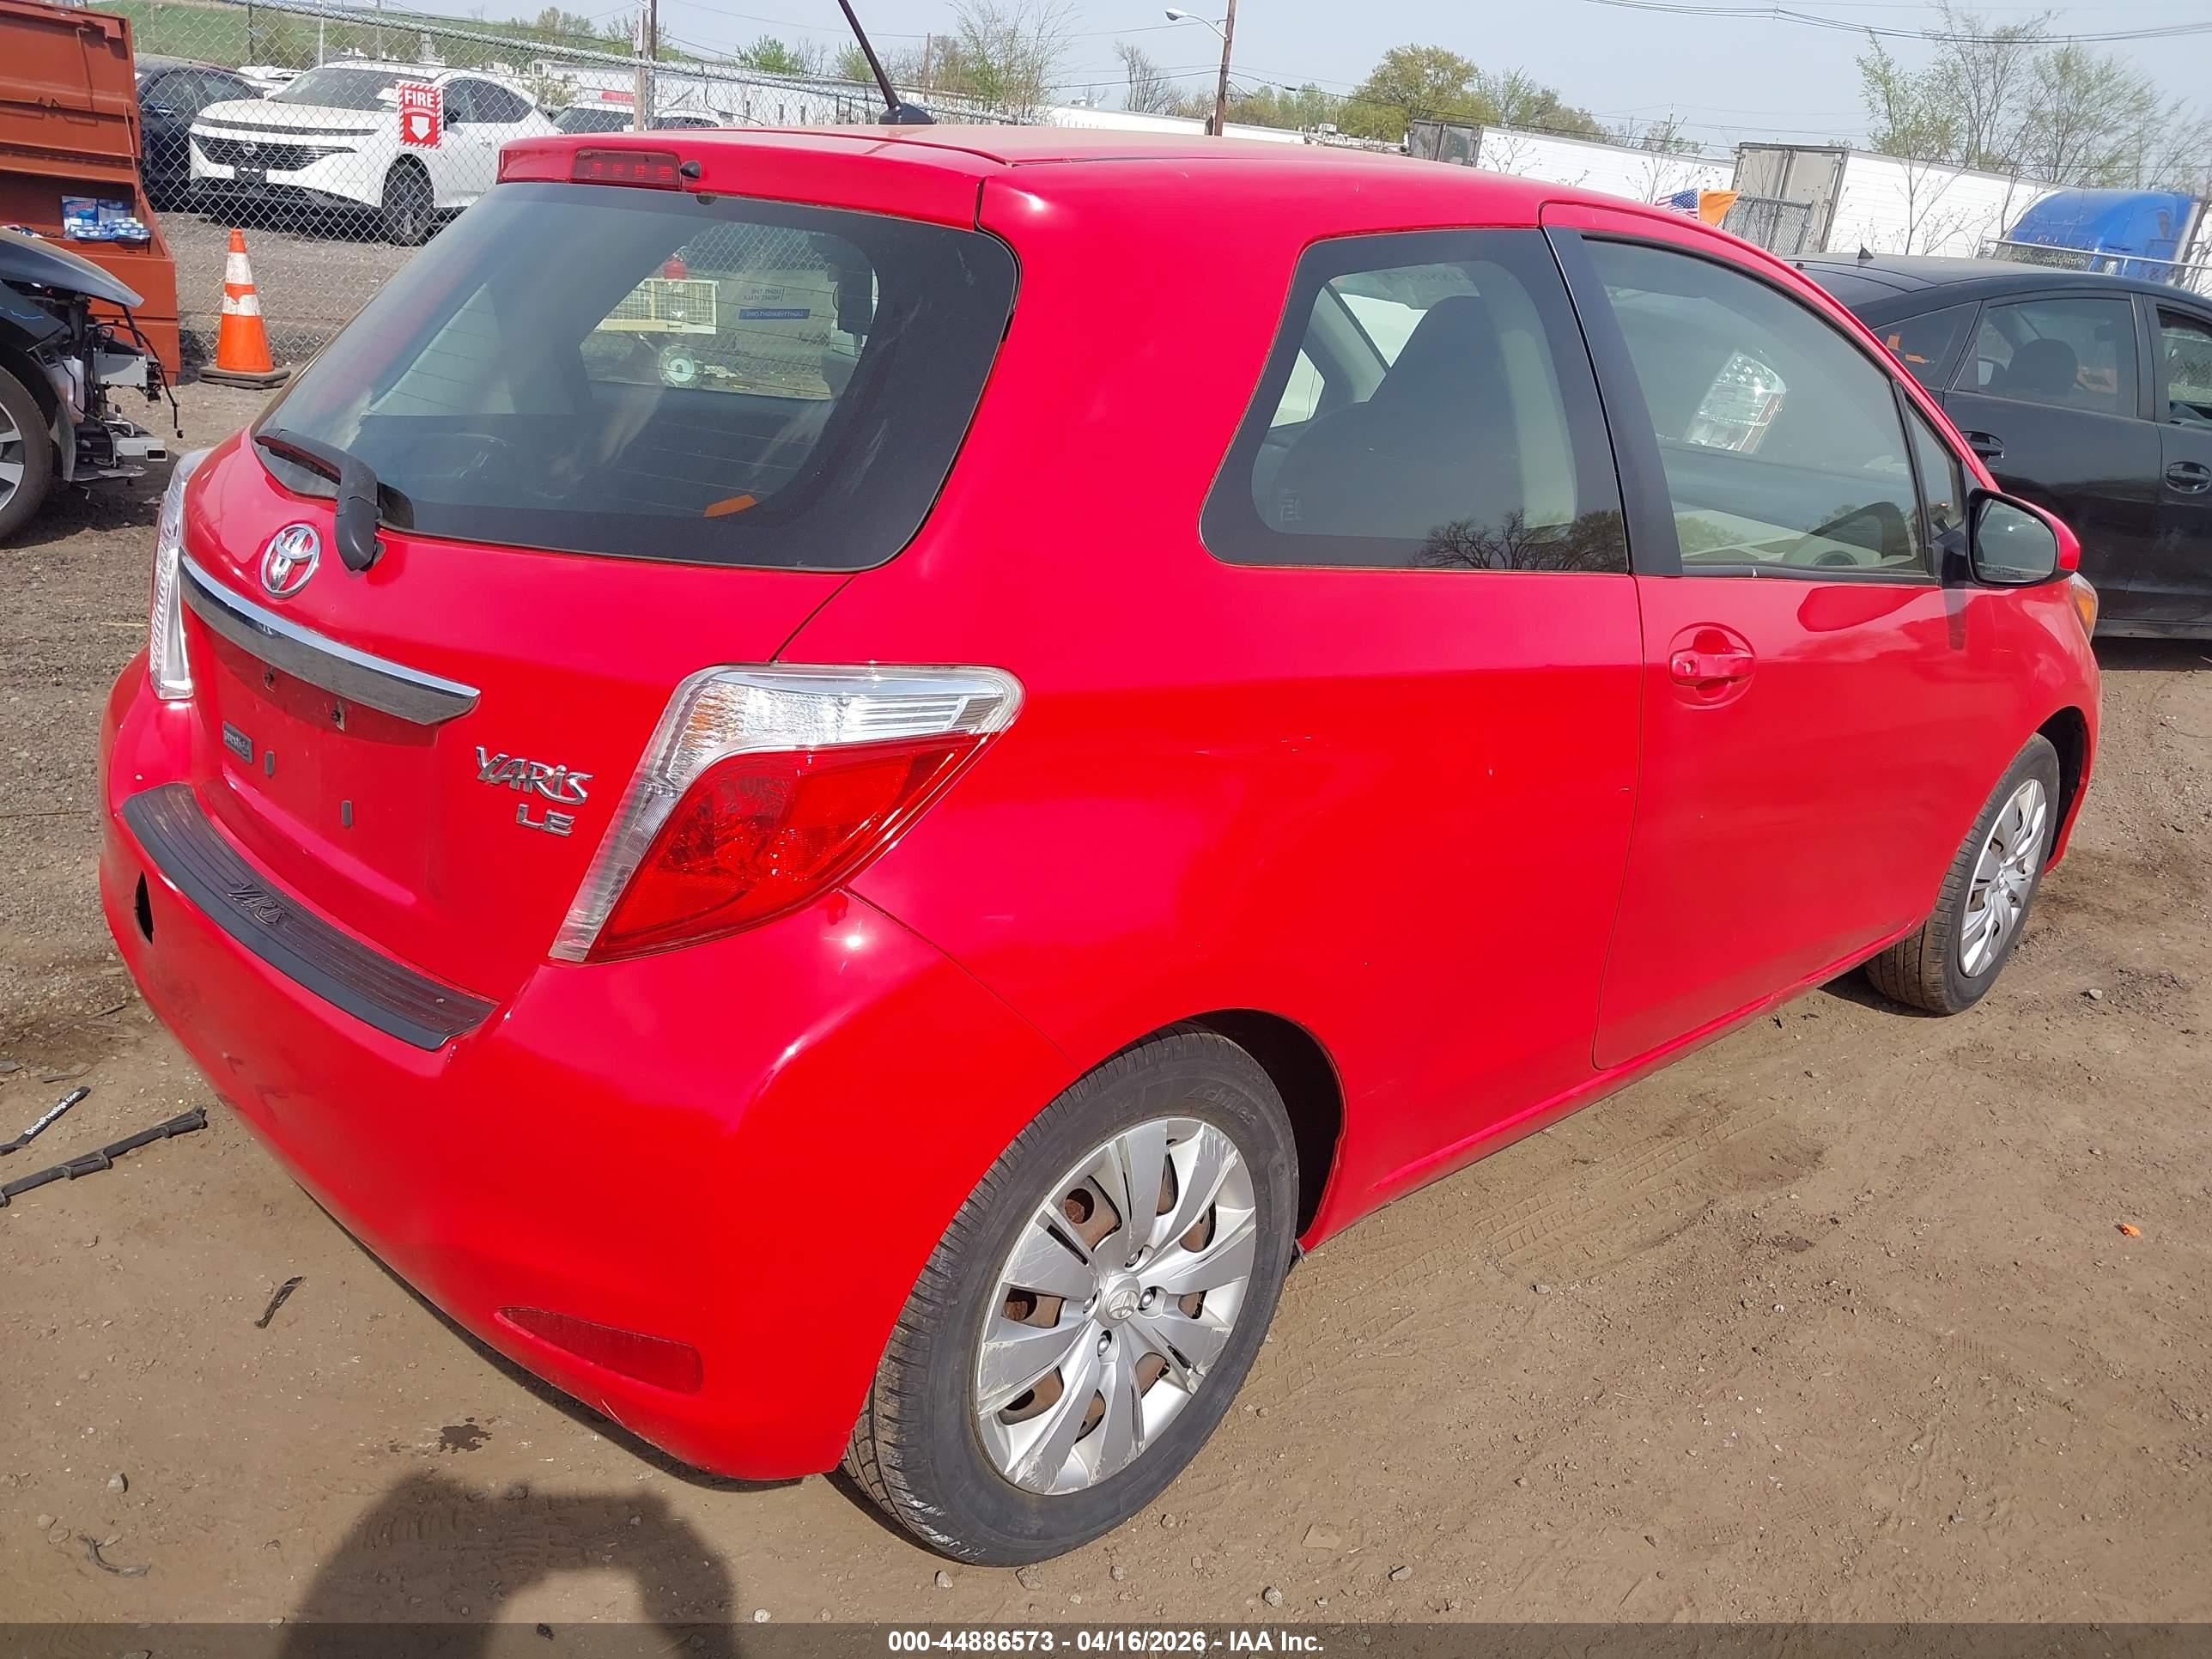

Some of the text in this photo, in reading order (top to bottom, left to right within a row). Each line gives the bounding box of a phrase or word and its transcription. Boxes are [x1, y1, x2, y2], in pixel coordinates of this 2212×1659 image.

[404, 89, 436, 108] FIRE
[516, 803, 575, 837] LE
[24, 1091, 82, 1135] DrivePrestige.com
